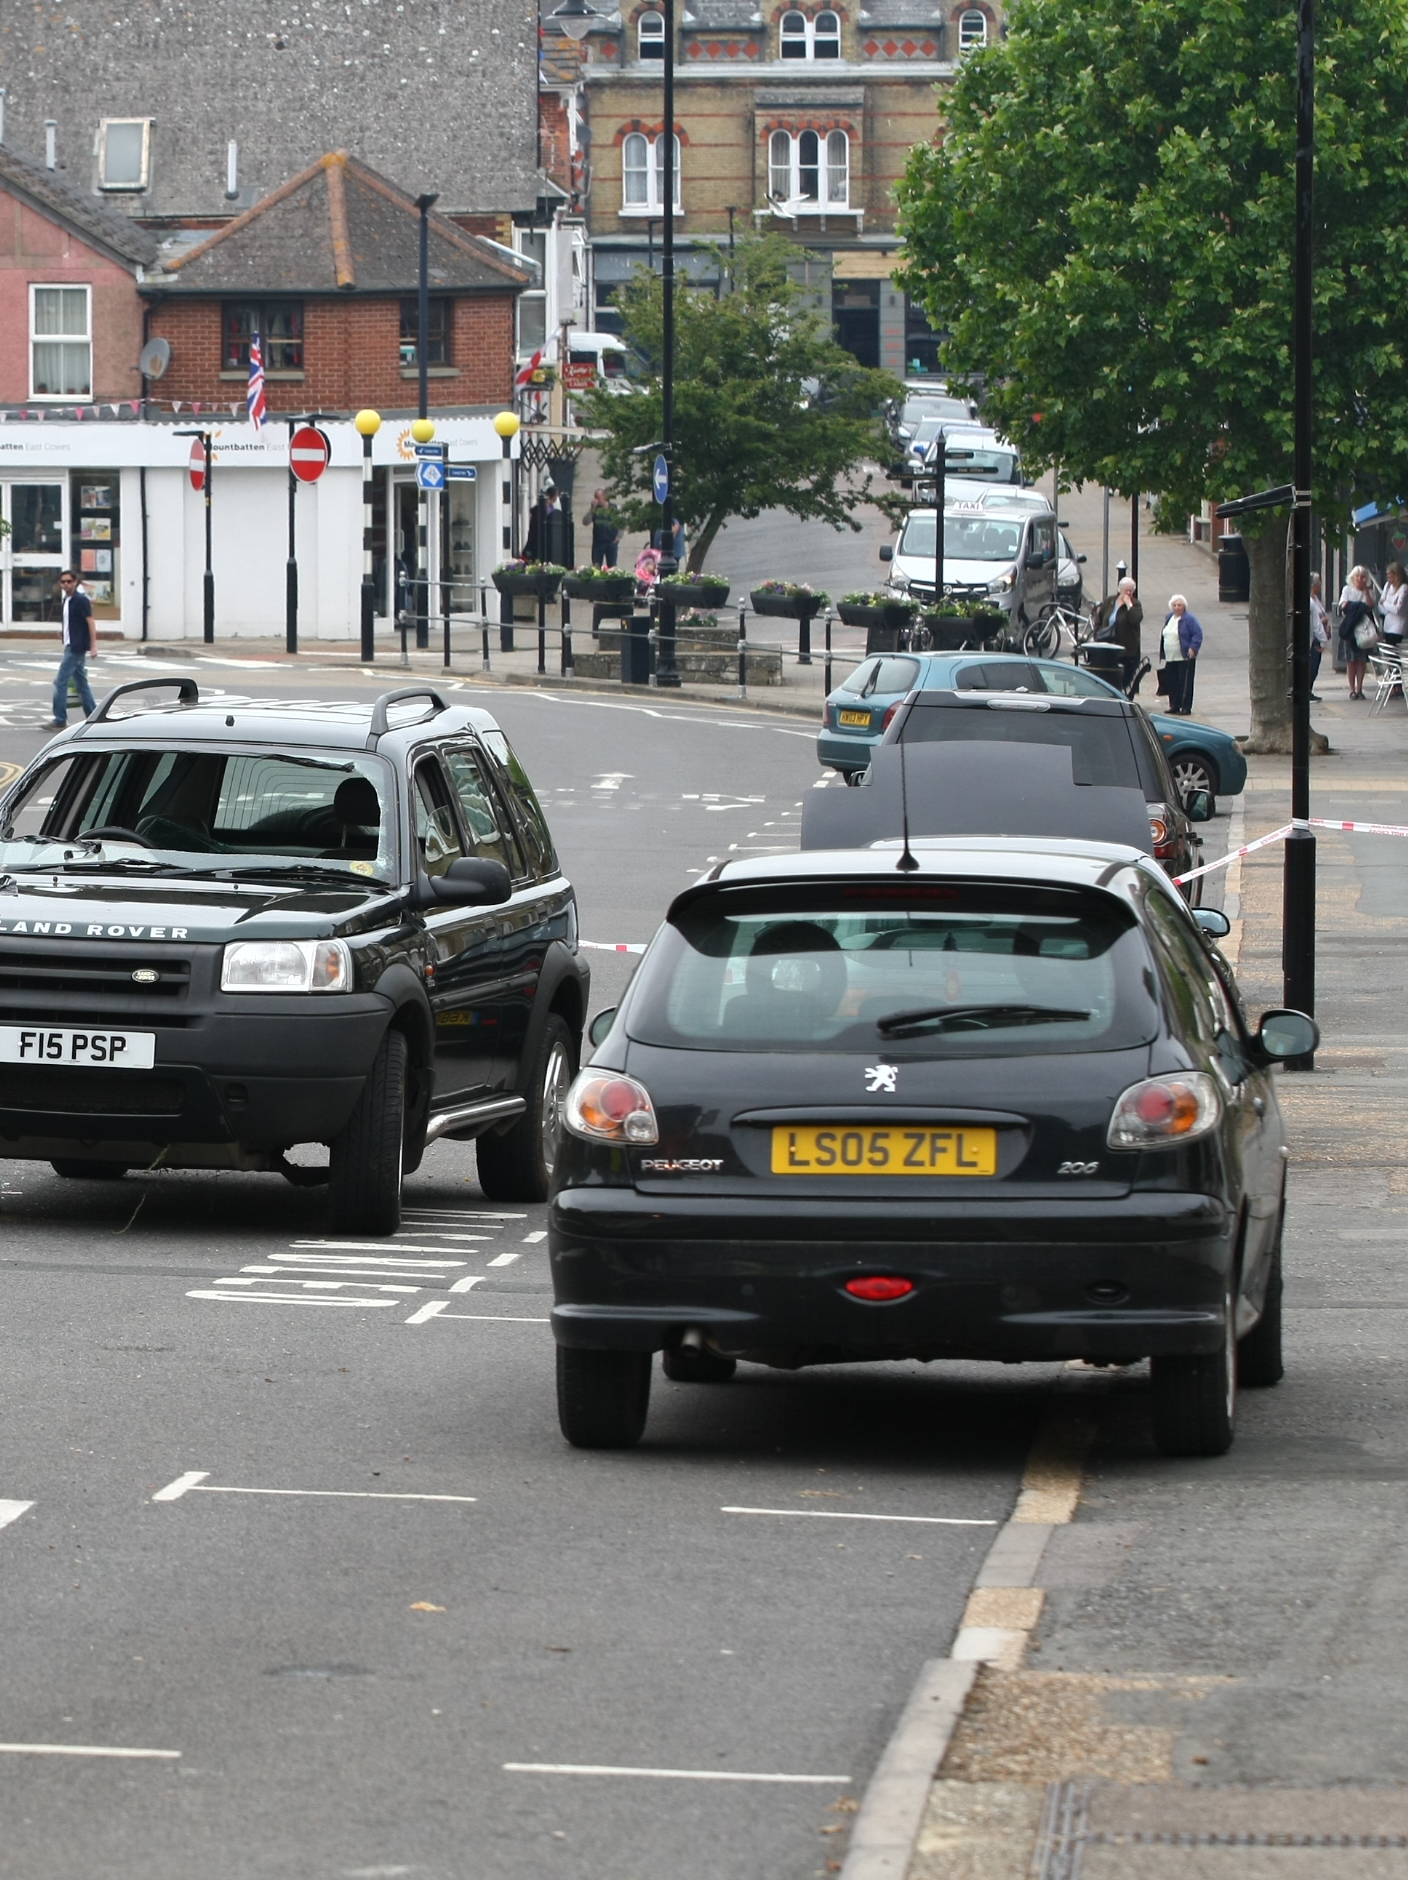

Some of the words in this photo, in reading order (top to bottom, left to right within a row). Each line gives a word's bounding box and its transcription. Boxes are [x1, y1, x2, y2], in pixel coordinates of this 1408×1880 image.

[25, 442, 43, 450] East
[44, 442, 71, 450] Cowes
[266, 443, 285, 451] East
[958, 502, 980, 510] TAXI
[86, 925, 188, 939] ROVER
[19, 1031, 64, 1060] F15
[71, 1034, 127, 1062] PSP
[788, 1131, 890, 1168] LS05
[903, 1133, 979, 1169] ZFL
[641, 1159, 724, 1171] PEUGEOT
[1056, 1161, 1100, 1174] 206
